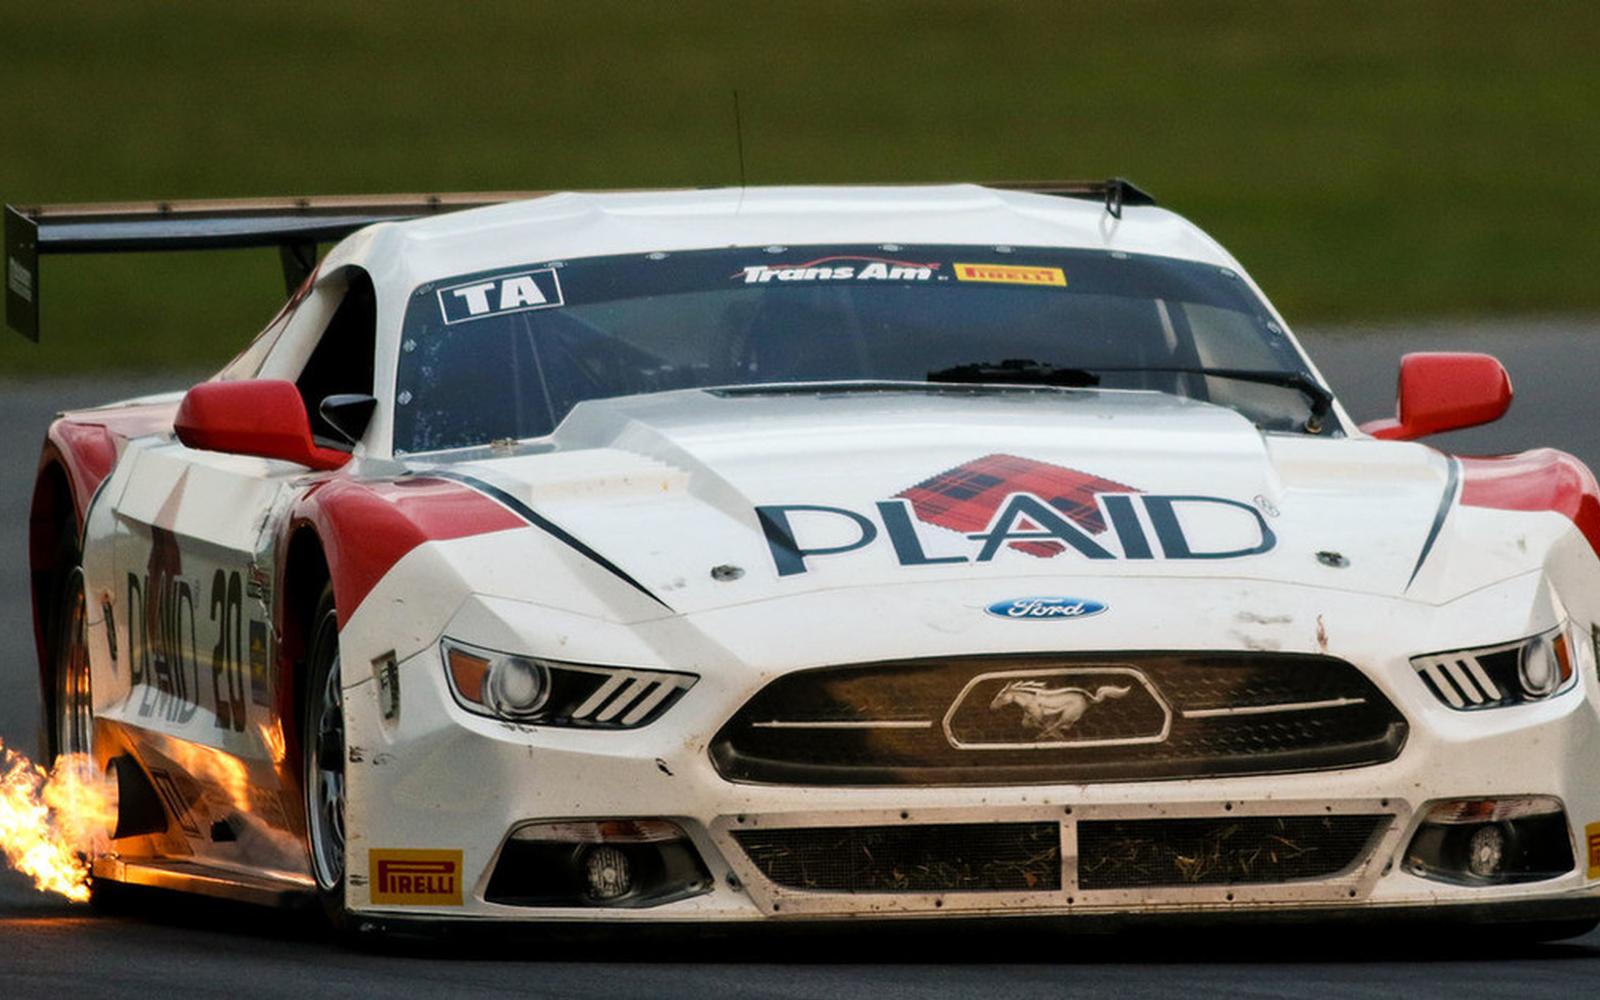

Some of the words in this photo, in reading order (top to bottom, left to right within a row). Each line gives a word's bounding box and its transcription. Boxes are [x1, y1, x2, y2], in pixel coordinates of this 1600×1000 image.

[744, 265, 854, 283] Trans
[857, 262, 931, 280] Am
[964, 266, 1054, 283] PIRELLI
[453, 275, 547, 315] TA
[755, 493, 1277, 577] PLAID
[1007, 598, 1085, 616] Ford
[210, 568, 246, 733] 20
[377, 859, 456, 894] PIRELLI
